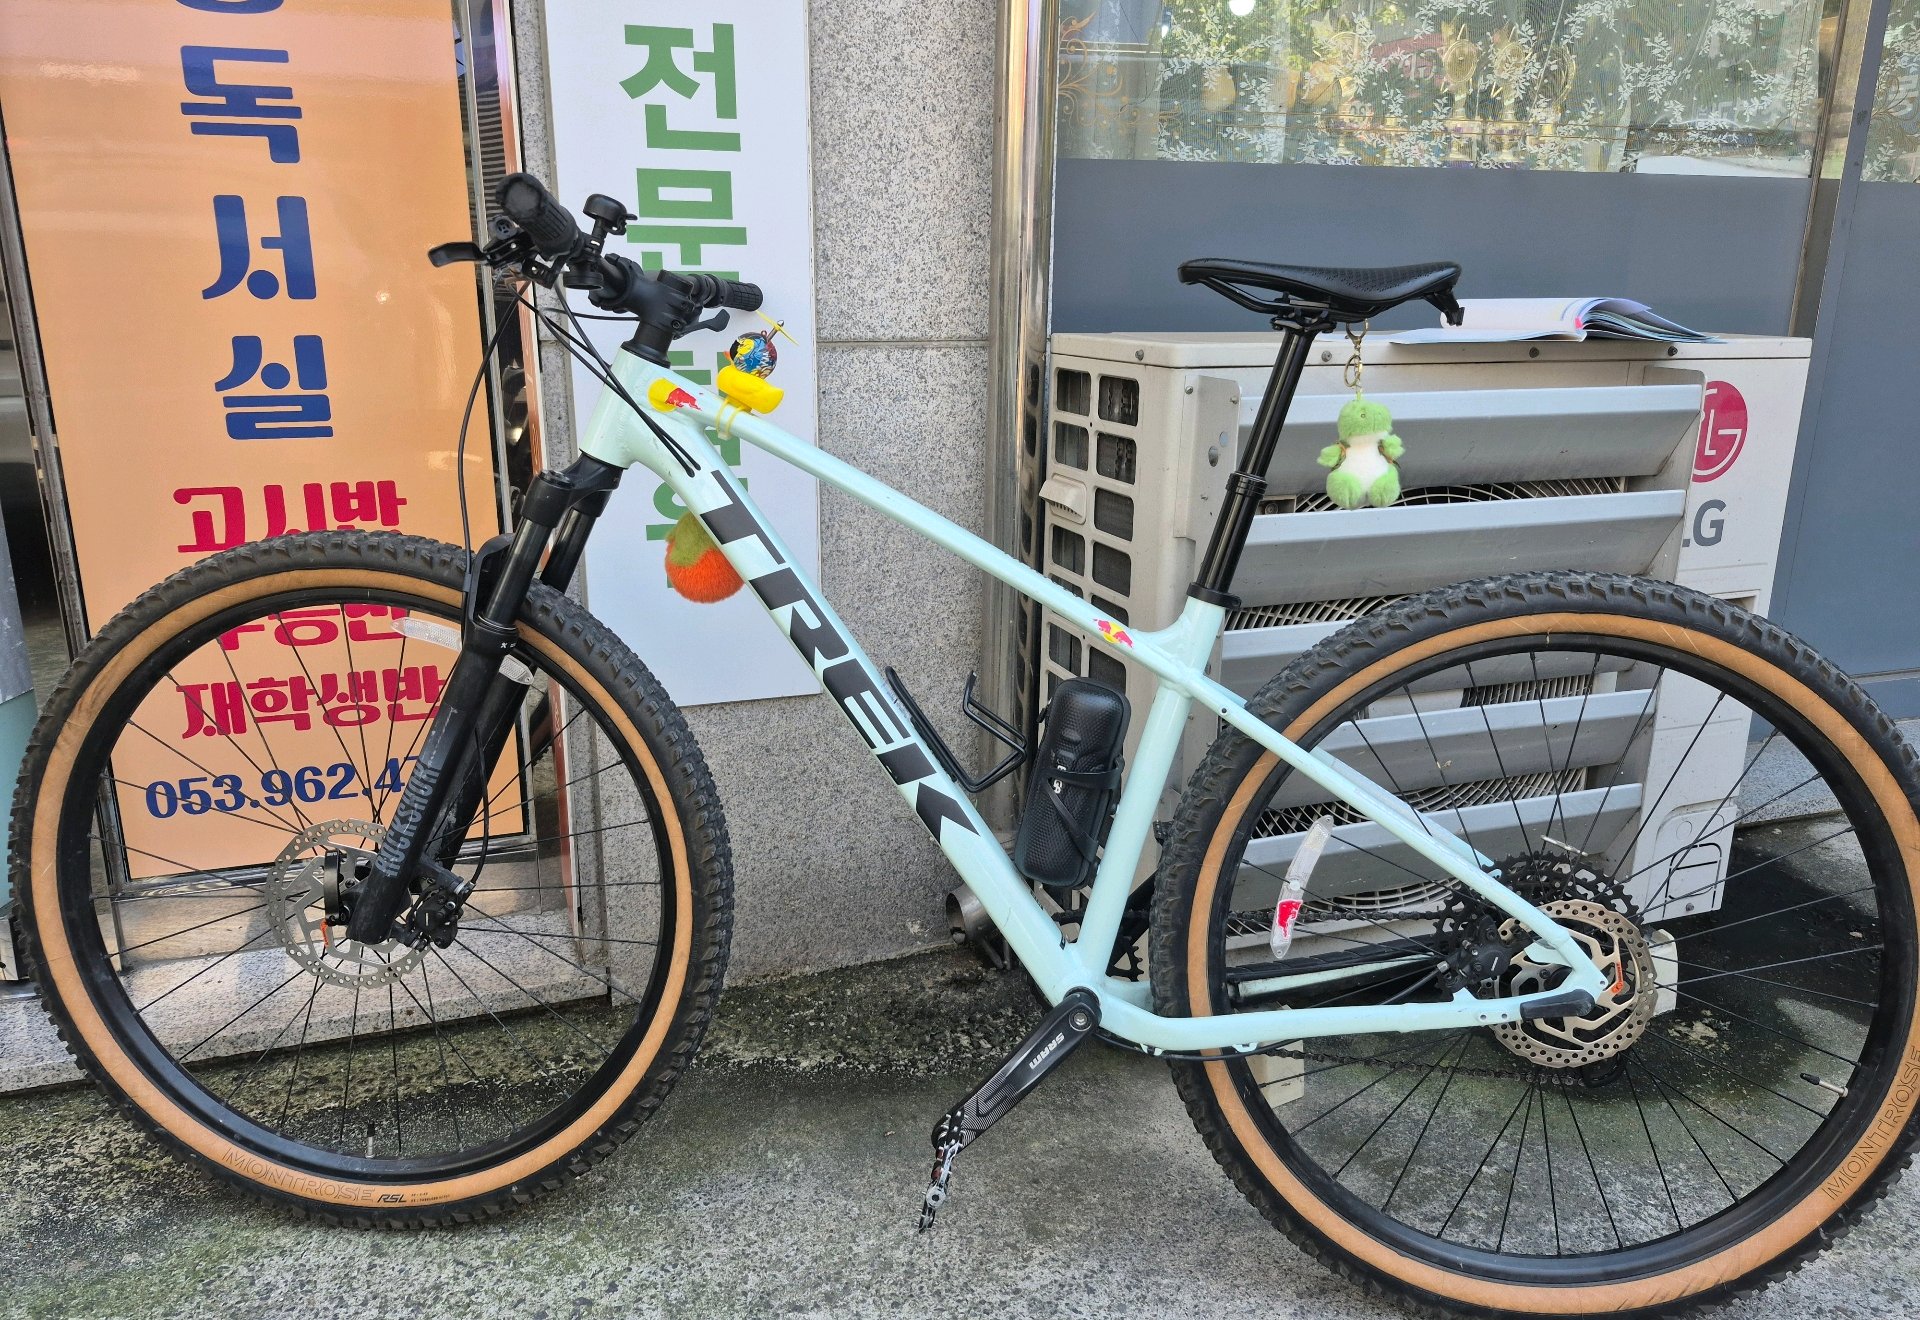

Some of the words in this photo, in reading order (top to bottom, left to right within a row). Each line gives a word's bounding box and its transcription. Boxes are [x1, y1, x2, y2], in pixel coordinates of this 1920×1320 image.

[1682, 499, 1727, 547] G
[700, 469, 980, 845] TREK
[176, 665, 446, 740] 재학생반
[1029, 1032, 1065, 1069] SRAM
[377, 1193, 407, 1203] RSL
